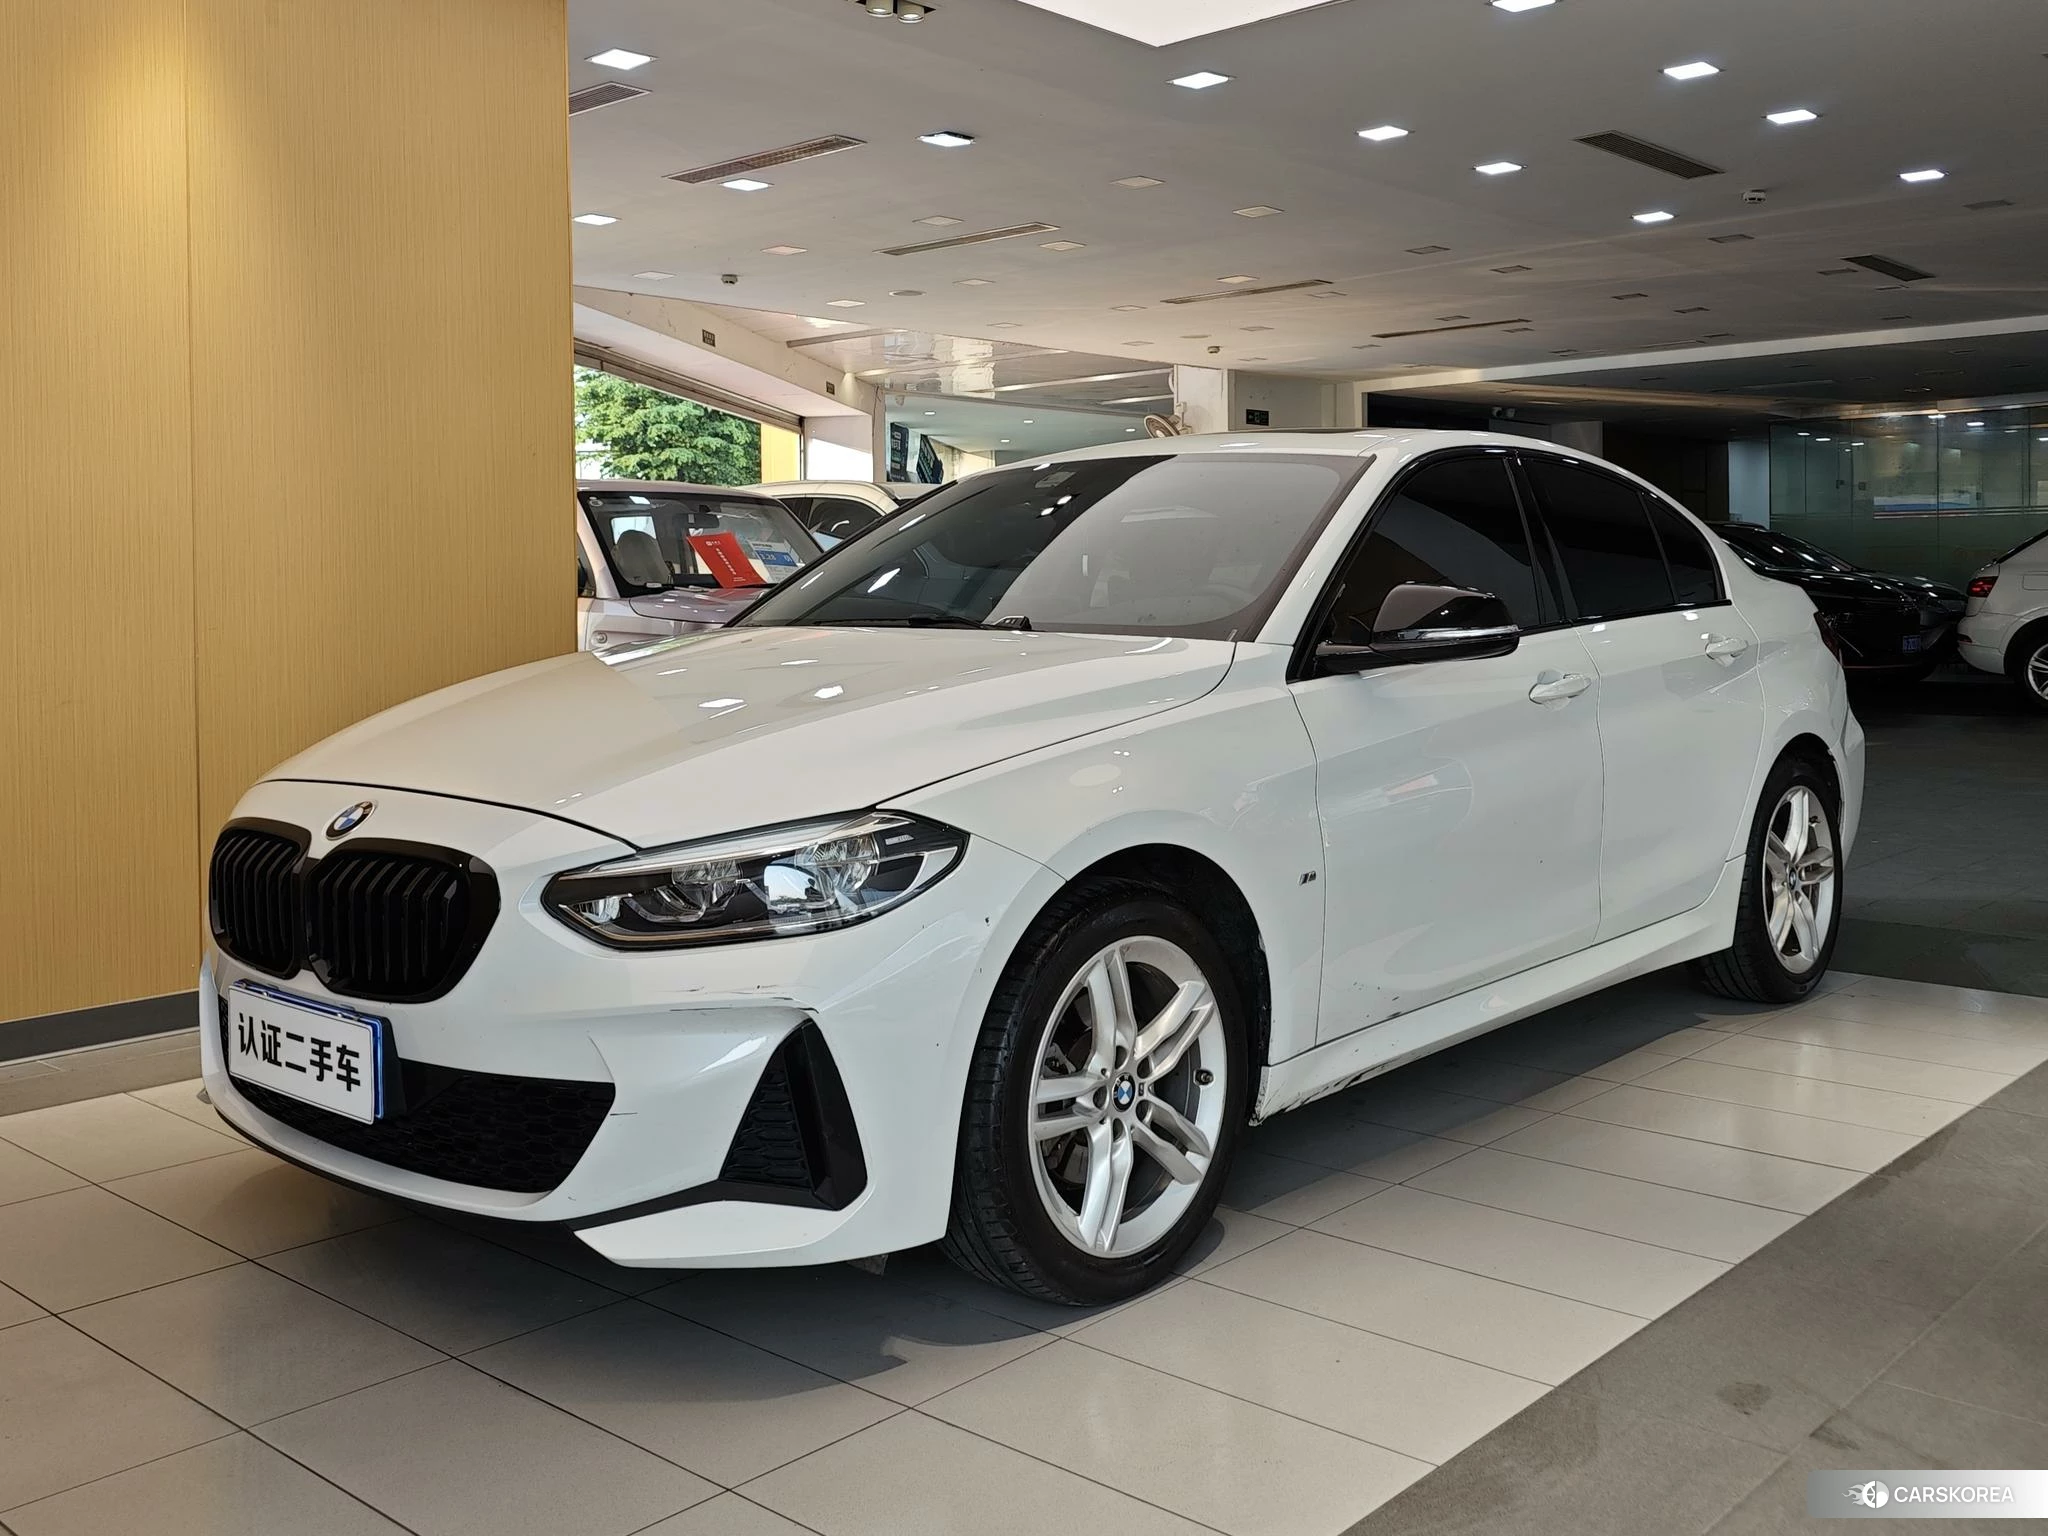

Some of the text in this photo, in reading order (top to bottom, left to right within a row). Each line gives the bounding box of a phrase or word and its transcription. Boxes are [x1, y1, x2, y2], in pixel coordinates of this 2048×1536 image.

[238, 1012, 361, 1092] 认证二手车
